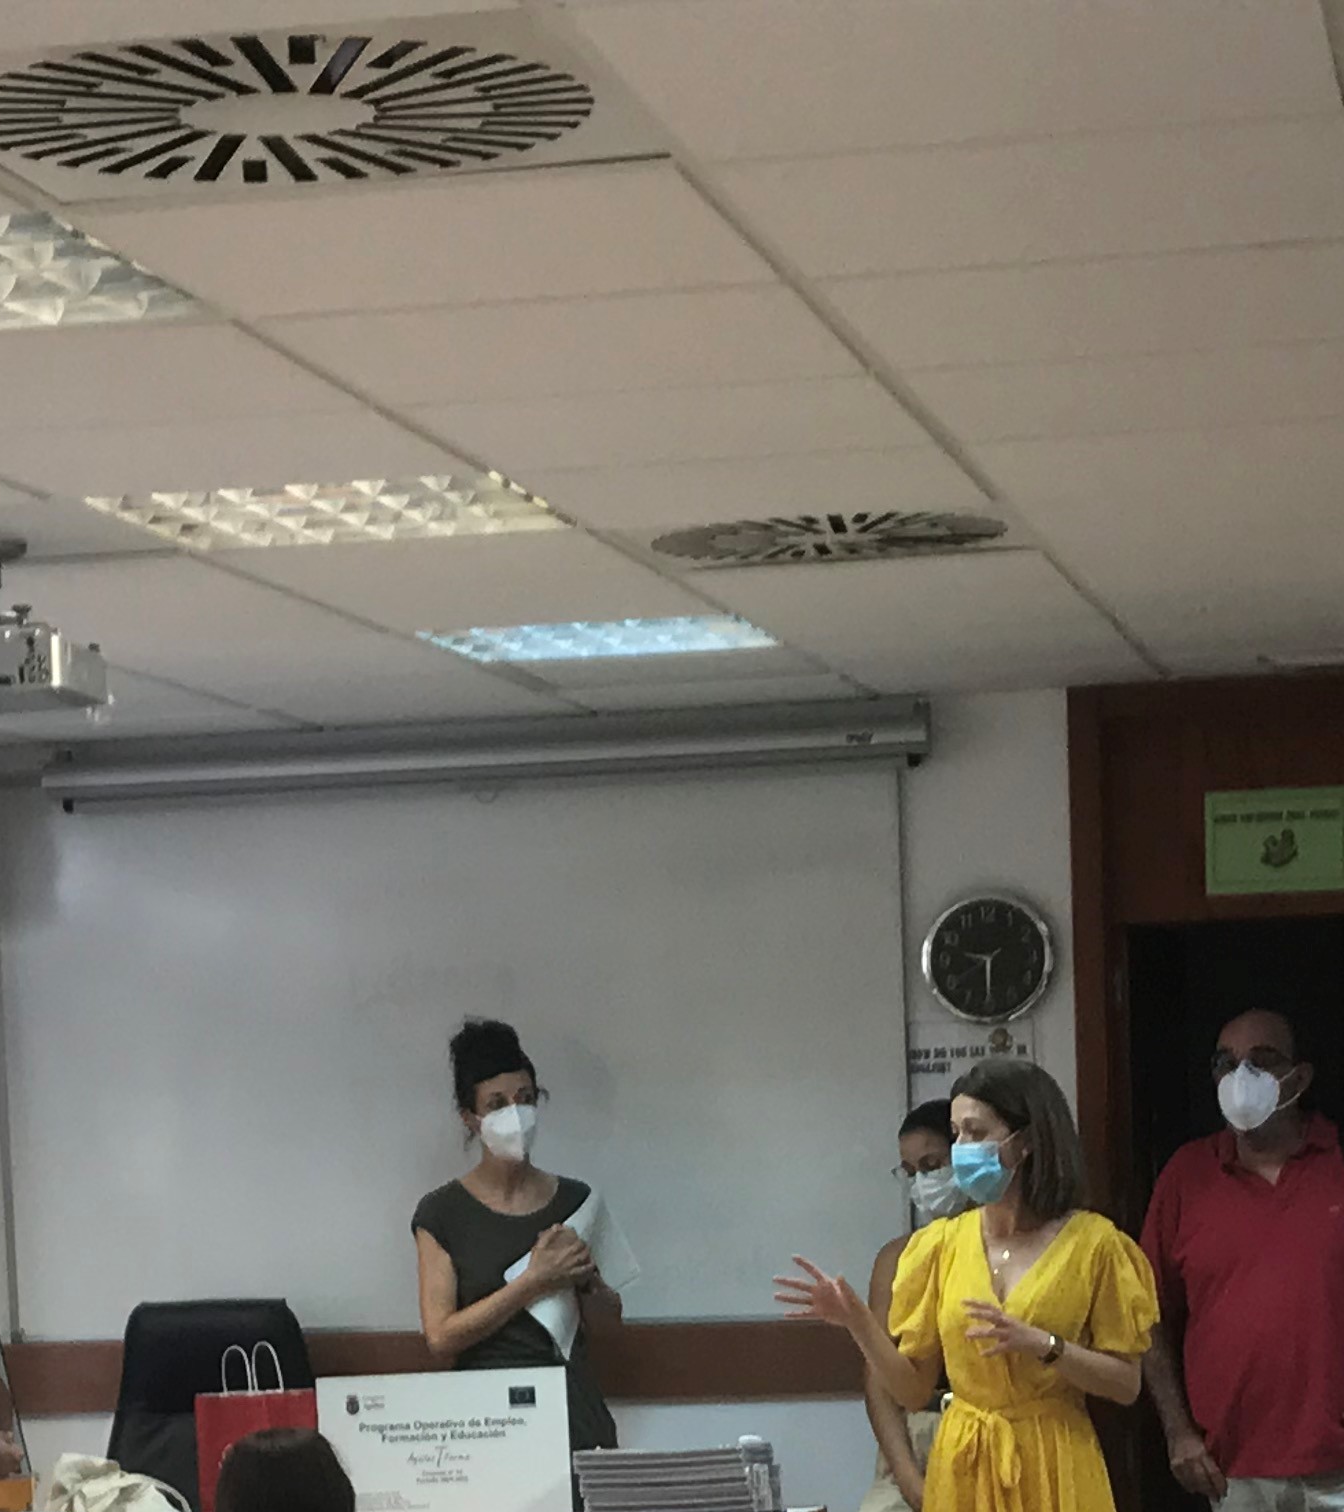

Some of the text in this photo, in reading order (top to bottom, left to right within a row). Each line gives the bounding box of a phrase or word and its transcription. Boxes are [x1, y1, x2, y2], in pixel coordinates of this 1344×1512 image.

[960, 913, 972, 929] 11
[980, 906, 996, 922] 12
[359, 1421, 411, 1434] Programa
[414, 1418, 465, 1431] Operativo
[468, 1417, 481, 1427] de
[382, 1431, 438, 1443] Formación
[450, 1429, 506, 1441] Educación
